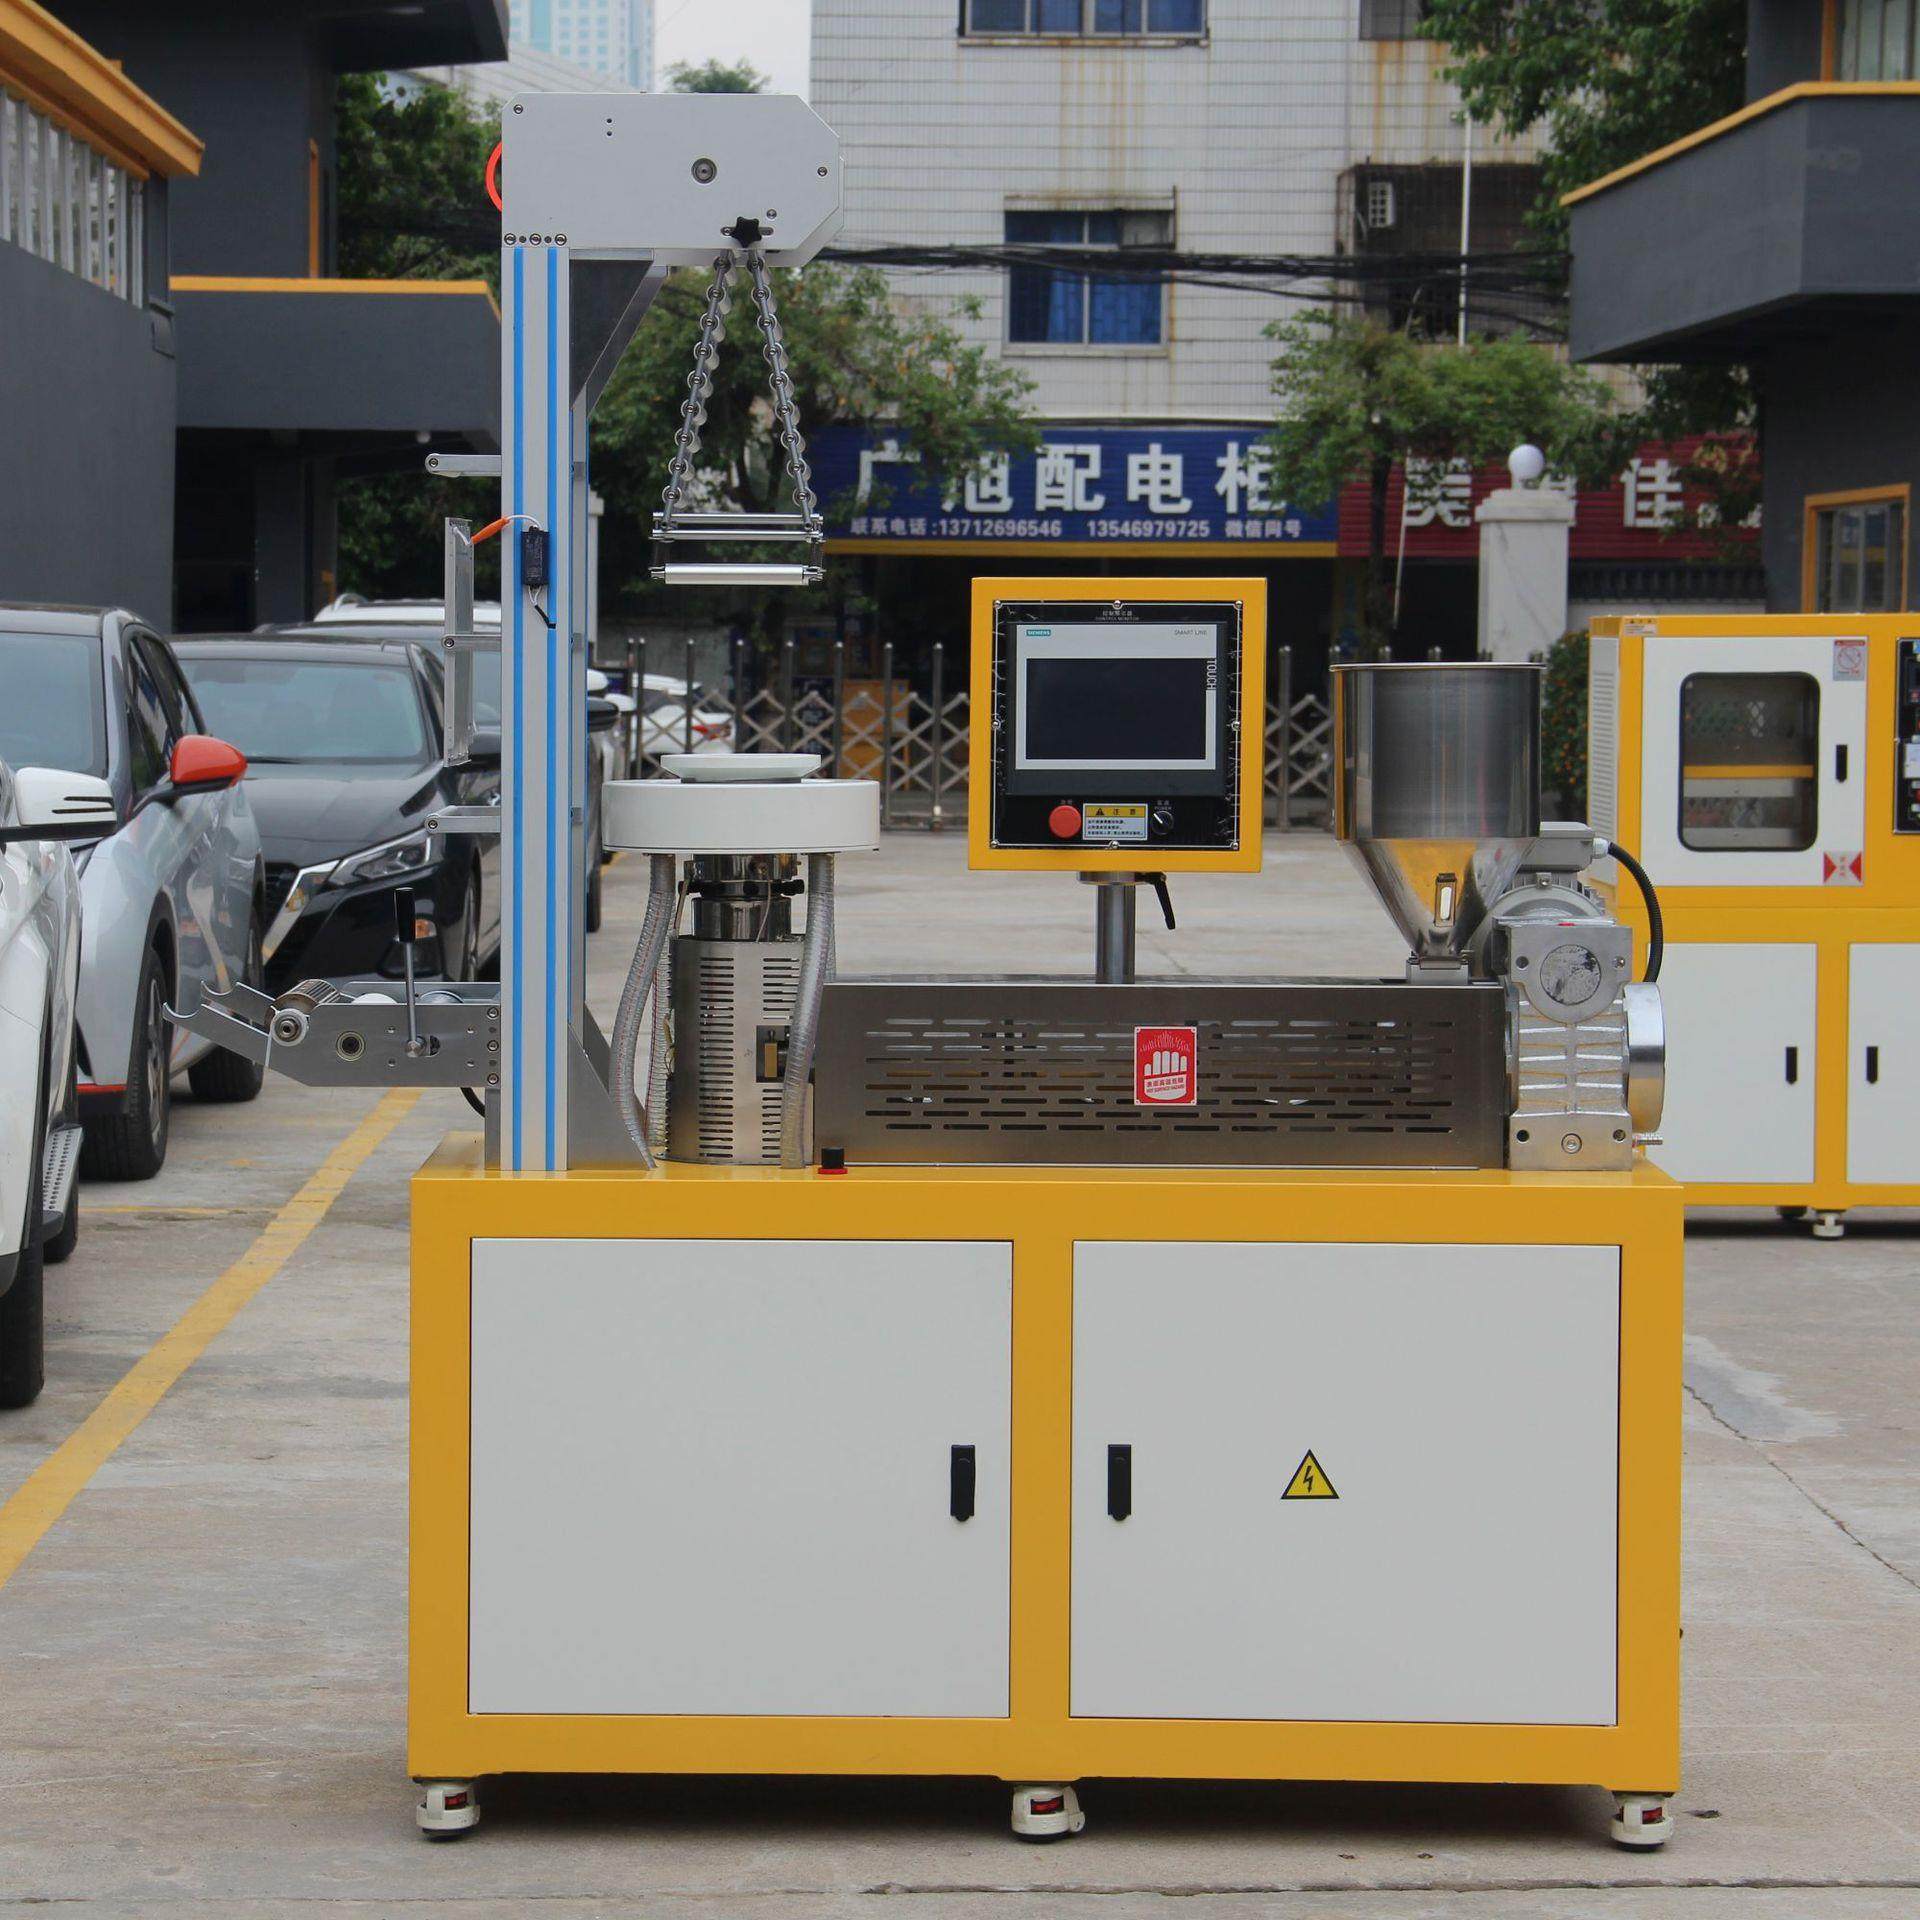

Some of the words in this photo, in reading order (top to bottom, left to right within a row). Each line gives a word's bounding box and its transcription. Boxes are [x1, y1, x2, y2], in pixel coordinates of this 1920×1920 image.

[1404, 456, 1684, 528] 美佳
[1087, 520, 1211, 538] 13546979725
[1206, 658, 1217, 690] TOUCH
